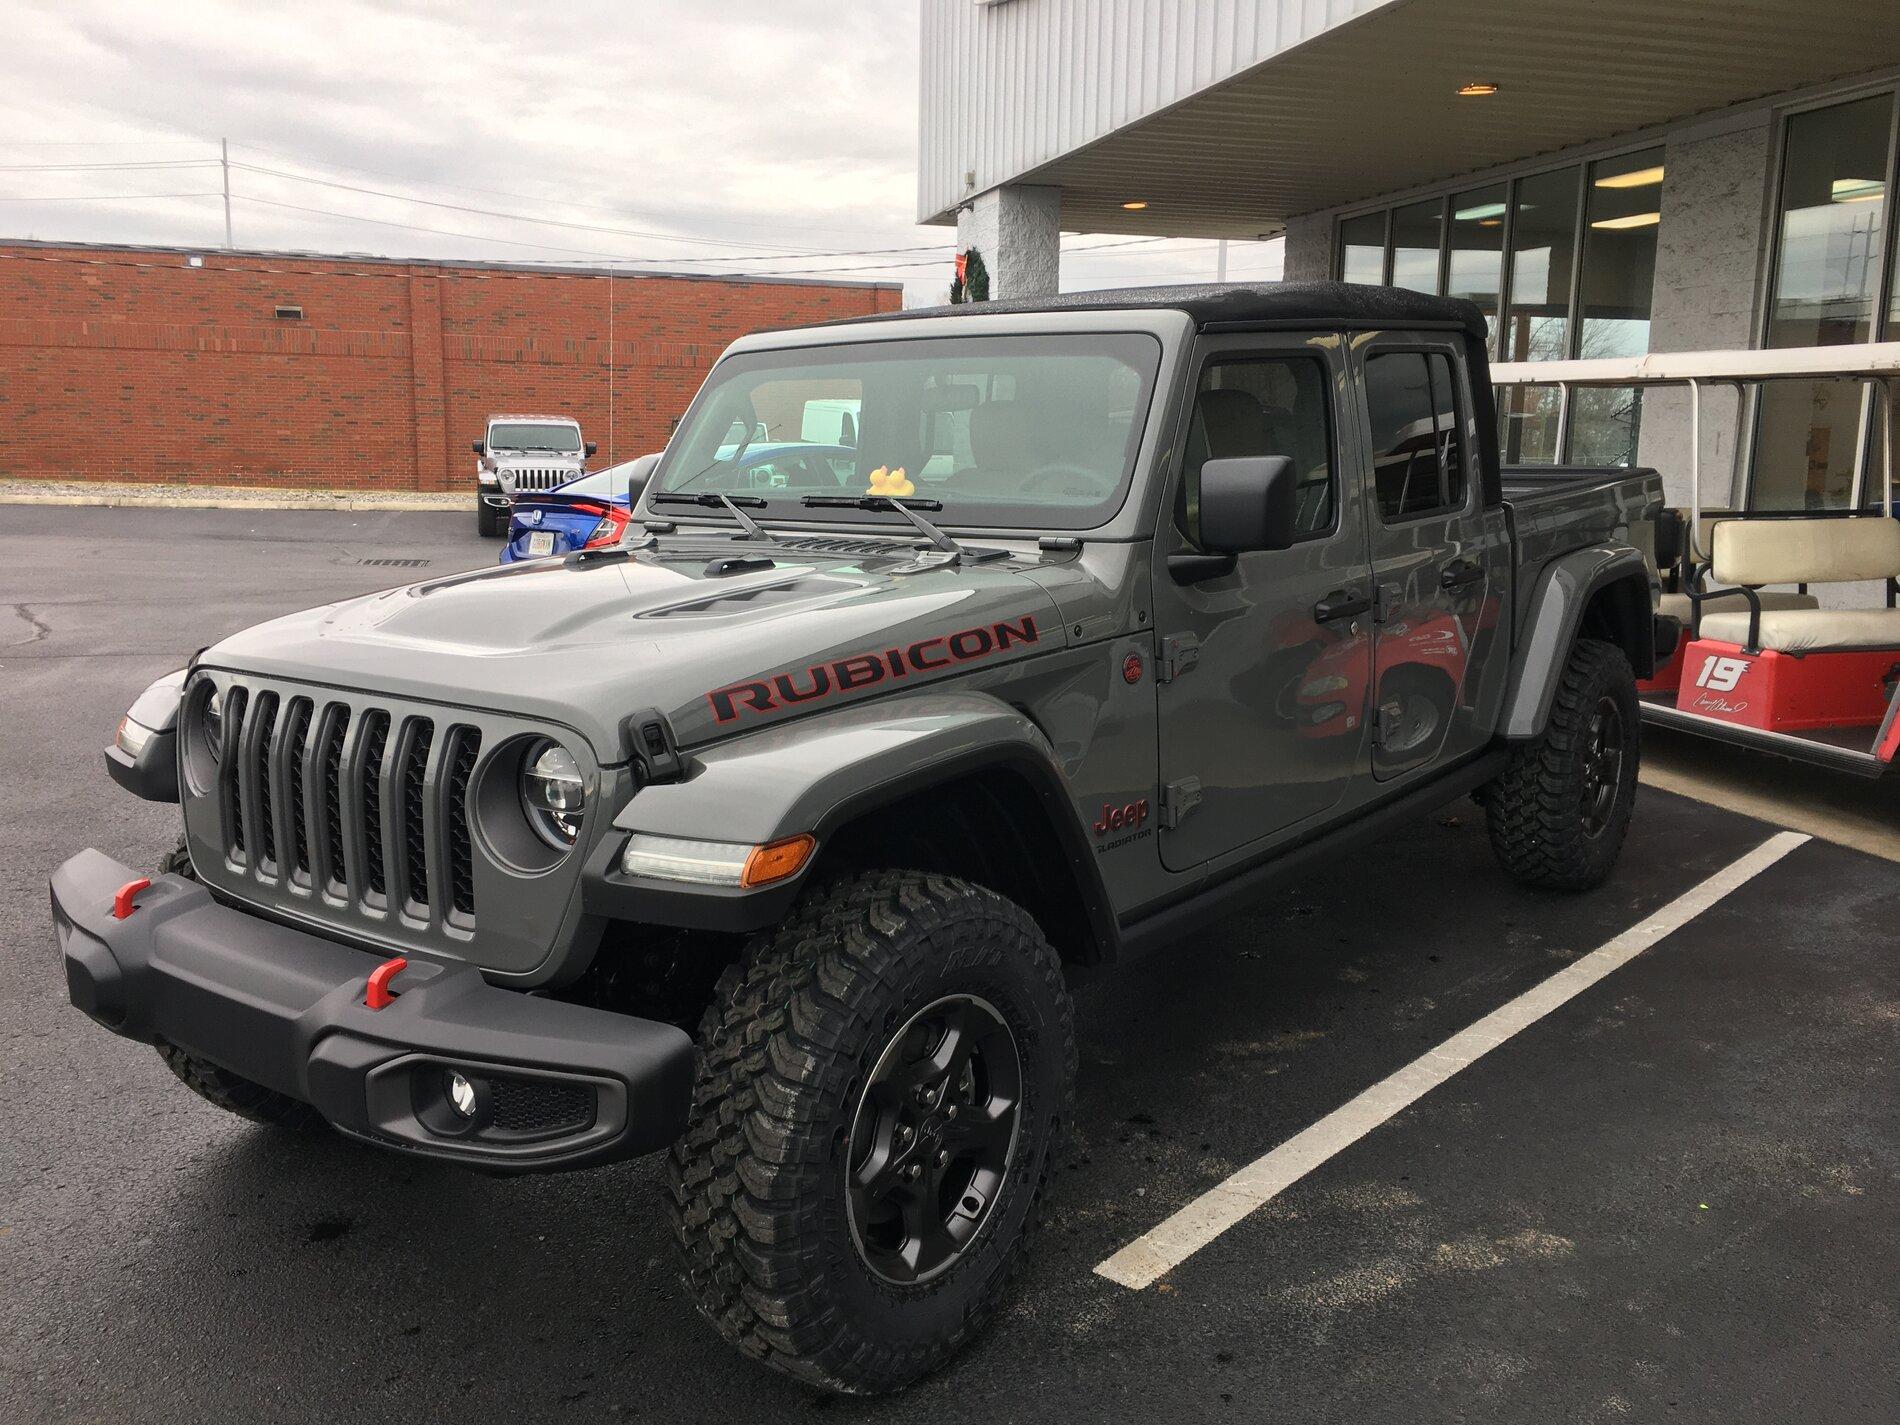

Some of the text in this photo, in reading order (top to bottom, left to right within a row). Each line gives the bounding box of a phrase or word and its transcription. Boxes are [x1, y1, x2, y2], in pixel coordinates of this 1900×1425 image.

[706, 615, 1039, 725] RUBICON
[1695, 655, 1752, 692] 19
[1092, 799, 1149, 836] Jeep
